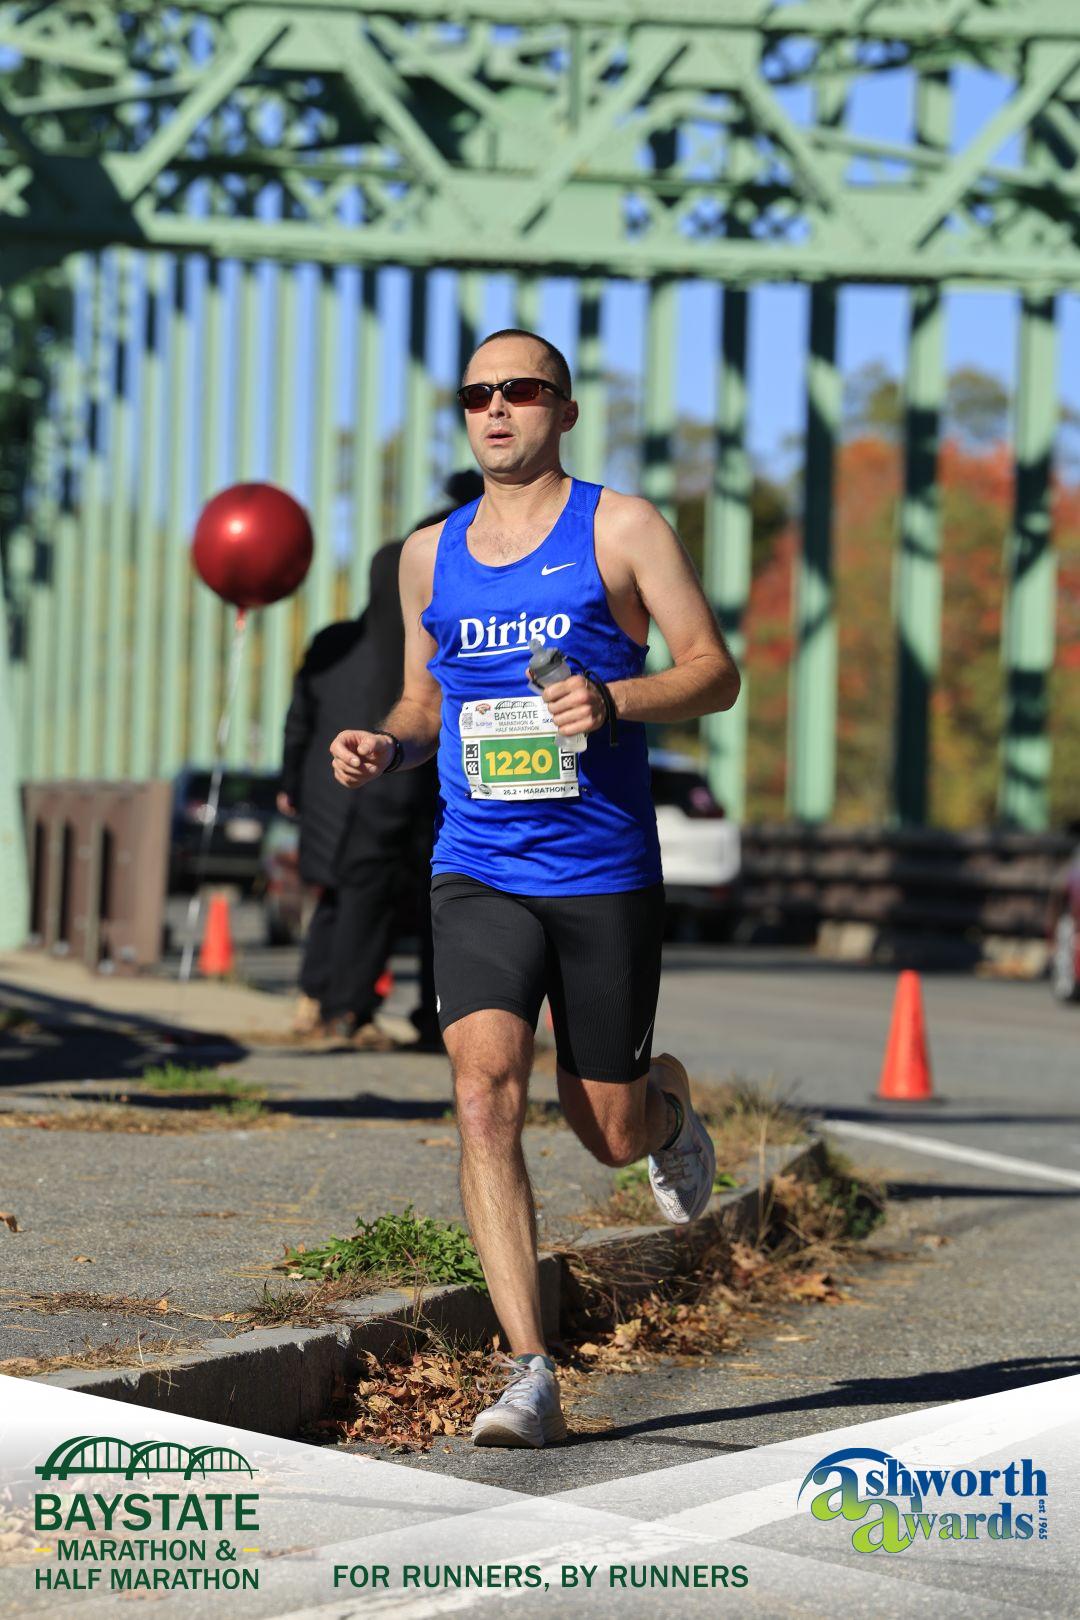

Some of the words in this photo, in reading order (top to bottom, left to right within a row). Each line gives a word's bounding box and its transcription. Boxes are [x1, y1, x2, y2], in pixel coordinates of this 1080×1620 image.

[459, 612, 571, 650] Dirigo
[494, 711, 539, 720] BAYSTATE
[485, 748, 553, 777] 1220
[523, 786, 566, 794] MARATHON
